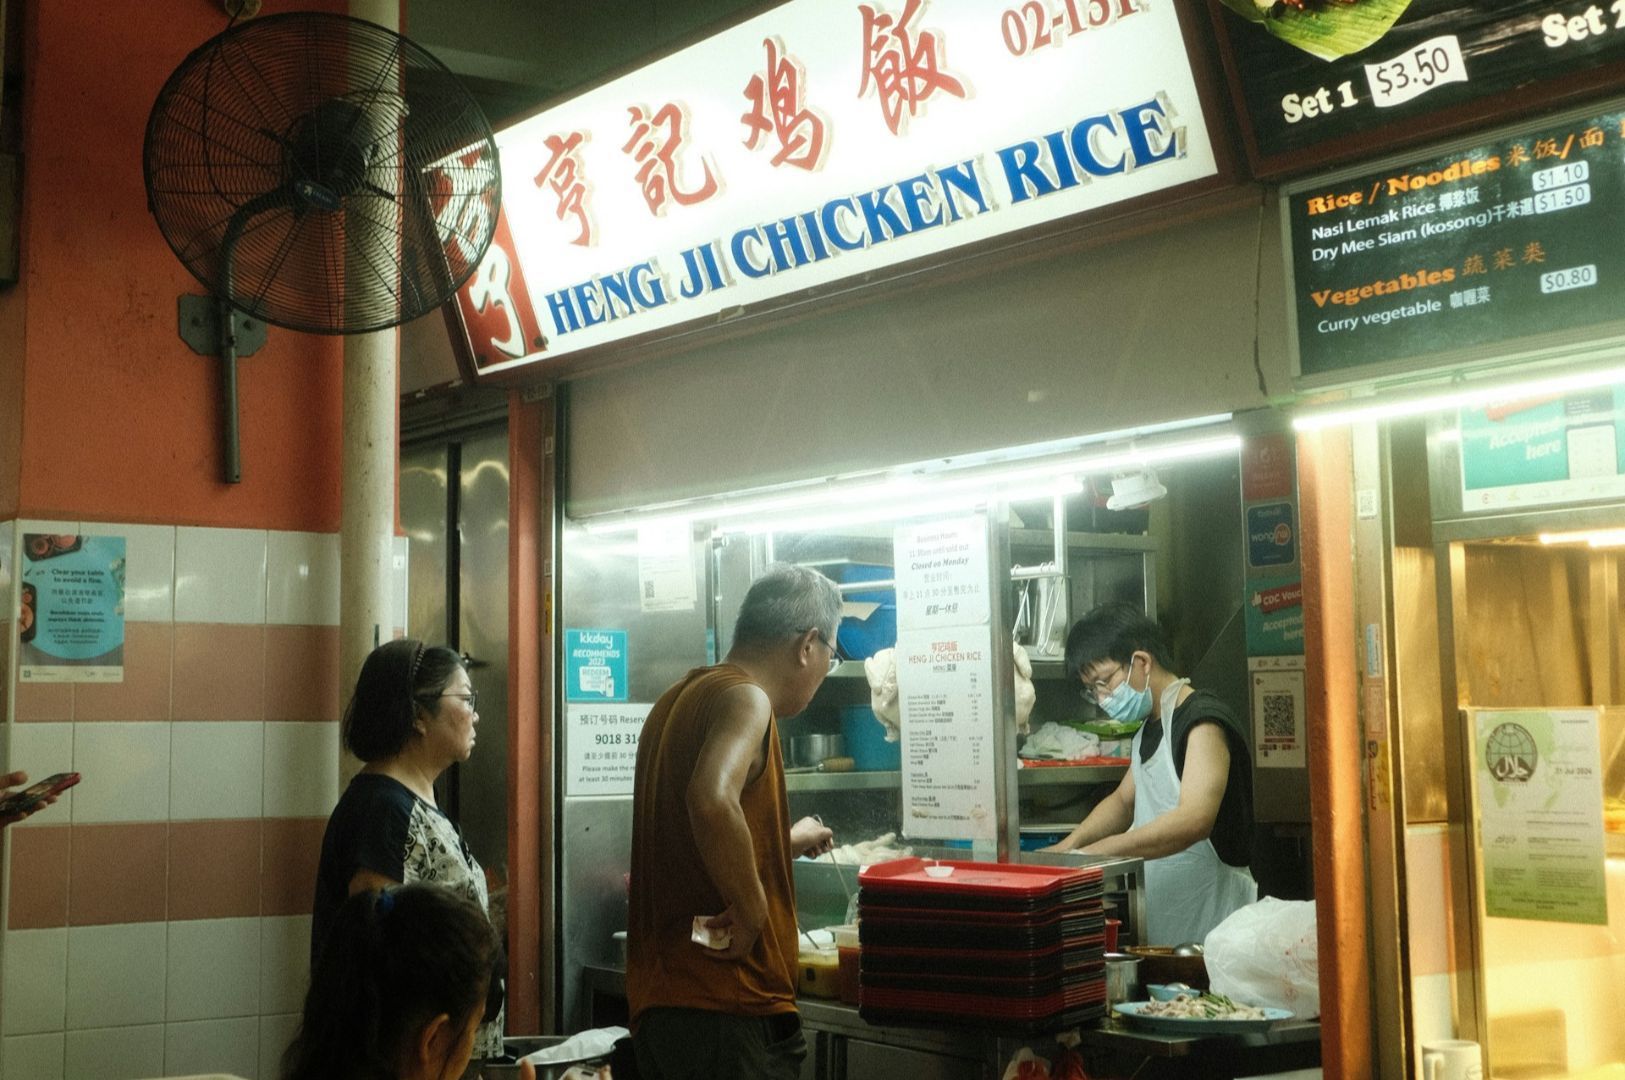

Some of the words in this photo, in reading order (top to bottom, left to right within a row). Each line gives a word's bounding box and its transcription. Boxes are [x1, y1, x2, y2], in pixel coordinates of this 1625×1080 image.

[1541, 5, 1607, 48] Set
[1376, 46, 1450, 97] $3.50
[1282, 87, 1334, 123] Set
[1337, 81, 1359, 108] 1
[1307, 191, 1363, 216] Rice
[1368, 181, 1381, 206] /
[1387, 155, 1501, 196] Noodles
[1537, 164, 1584, 188] $1.10
[1539, 186, 1585, 211] $1.50
[545, 262, 669, 336] HENG
[679, 239, 727, 298] JI
[731, 160, 991, 279] CHICKEN
[995, 99, 1178, 204] RICE
[1312, 222, 1344, 241] Nasi
[1347, 209, 1400, 233] Lemak
[1402, 202, 1437, 220] Rice
[1312, 246, 1338, 262] Dry
[1342, 238, 1375, 256] Mee
[1378, 229, 1417, 247] Siam
[1311, 268, 1456, 309] Vegetables
[1545, 267, 1592, 291] $0.80
[1318, 317, 1359, 334] Curry
[1362, 299, 1442, 325] vegetable
[1525, 439, 1562, 461] here
[1263, 592, 1281, 606] CDC
[573, 649, 621, 658] RECOMMENDS
[580, 631, 613, 649] kkday
[595, 733, 622, 745] 9018
[624, 733, 639, 744] 31
[582, 765, 601, 773] Please
